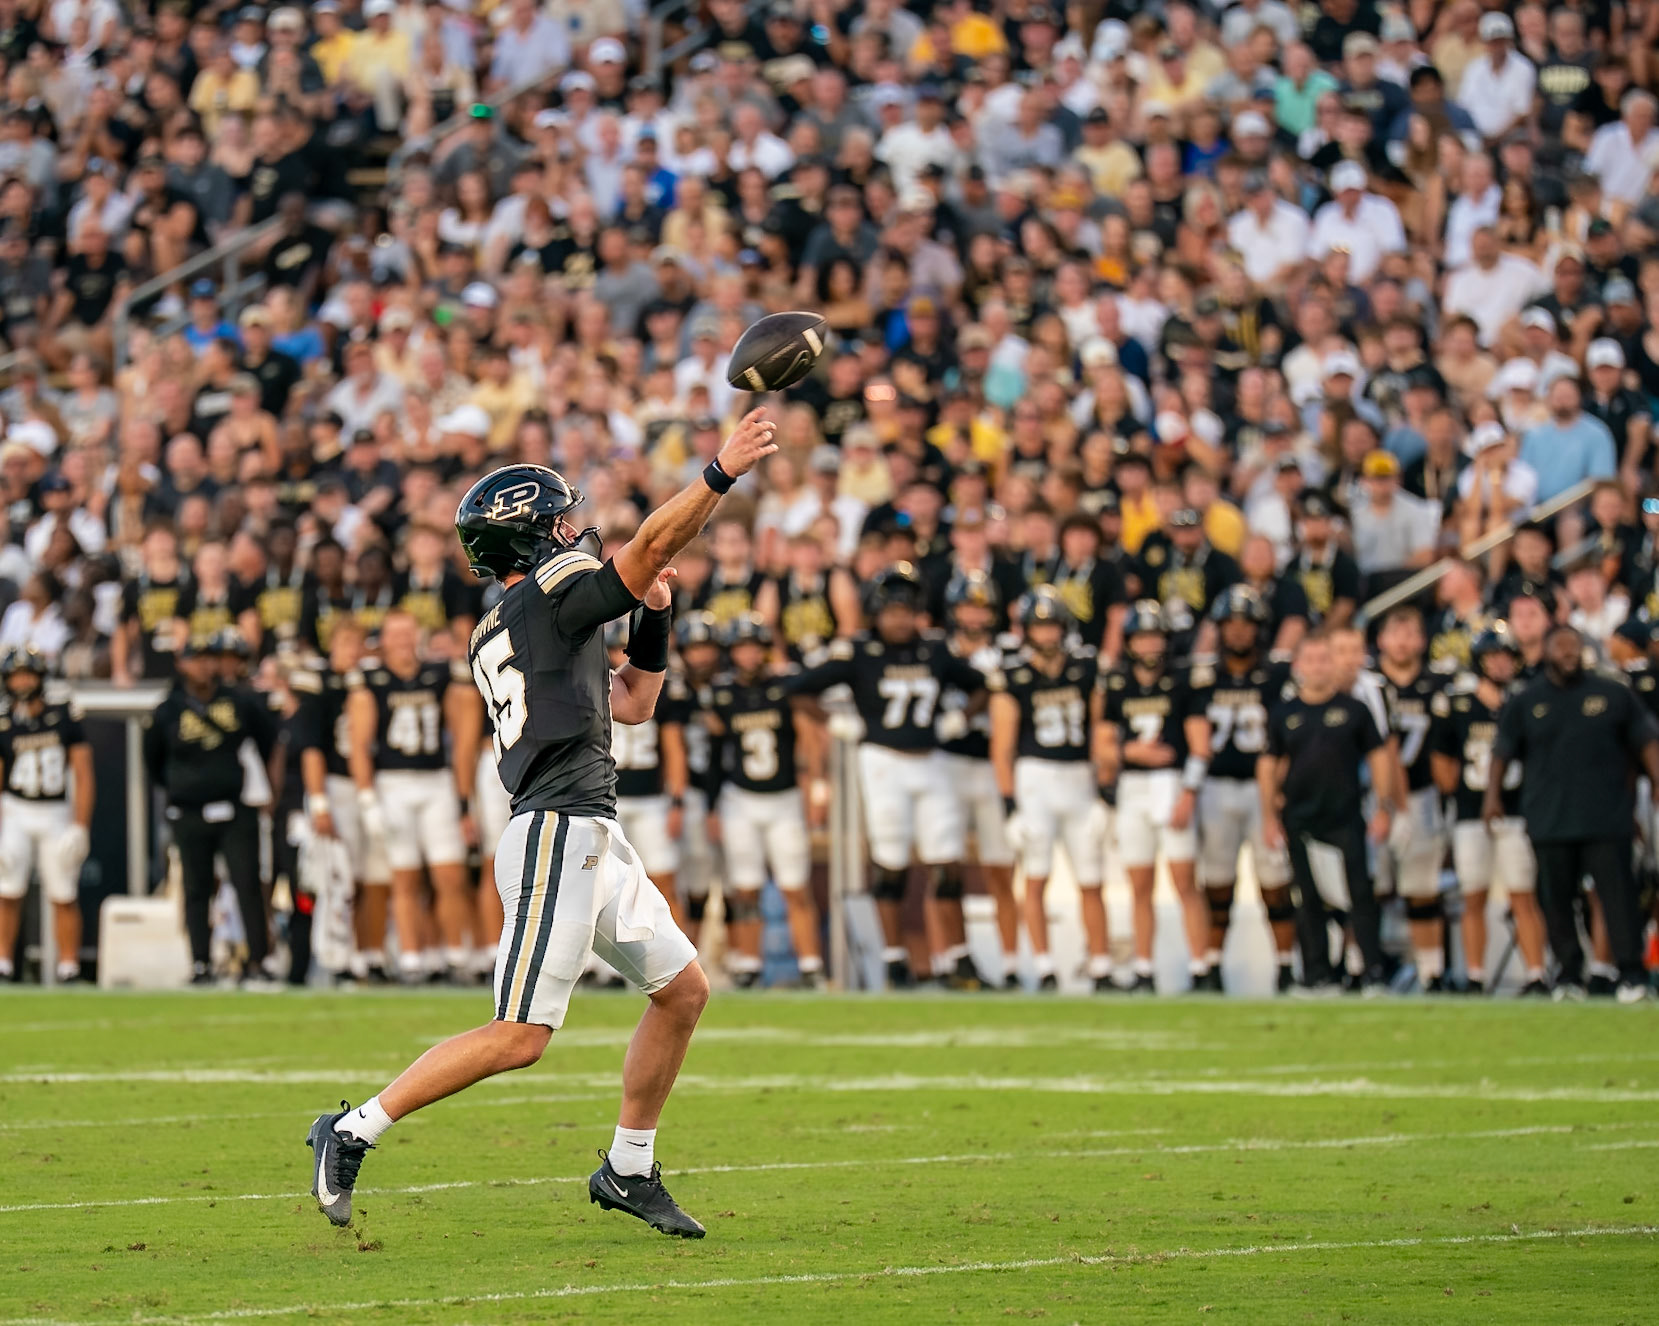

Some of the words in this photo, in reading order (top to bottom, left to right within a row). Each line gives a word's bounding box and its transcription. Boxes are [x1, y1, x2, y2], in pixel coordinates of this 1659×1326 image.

[386, 702, 440, 756] 41
[878, 677, 940, 729] 77
[1205, 701, 1269, 753] 73
[9, 747, 66, 797] 48
[741, 727, 779, 781] 3
